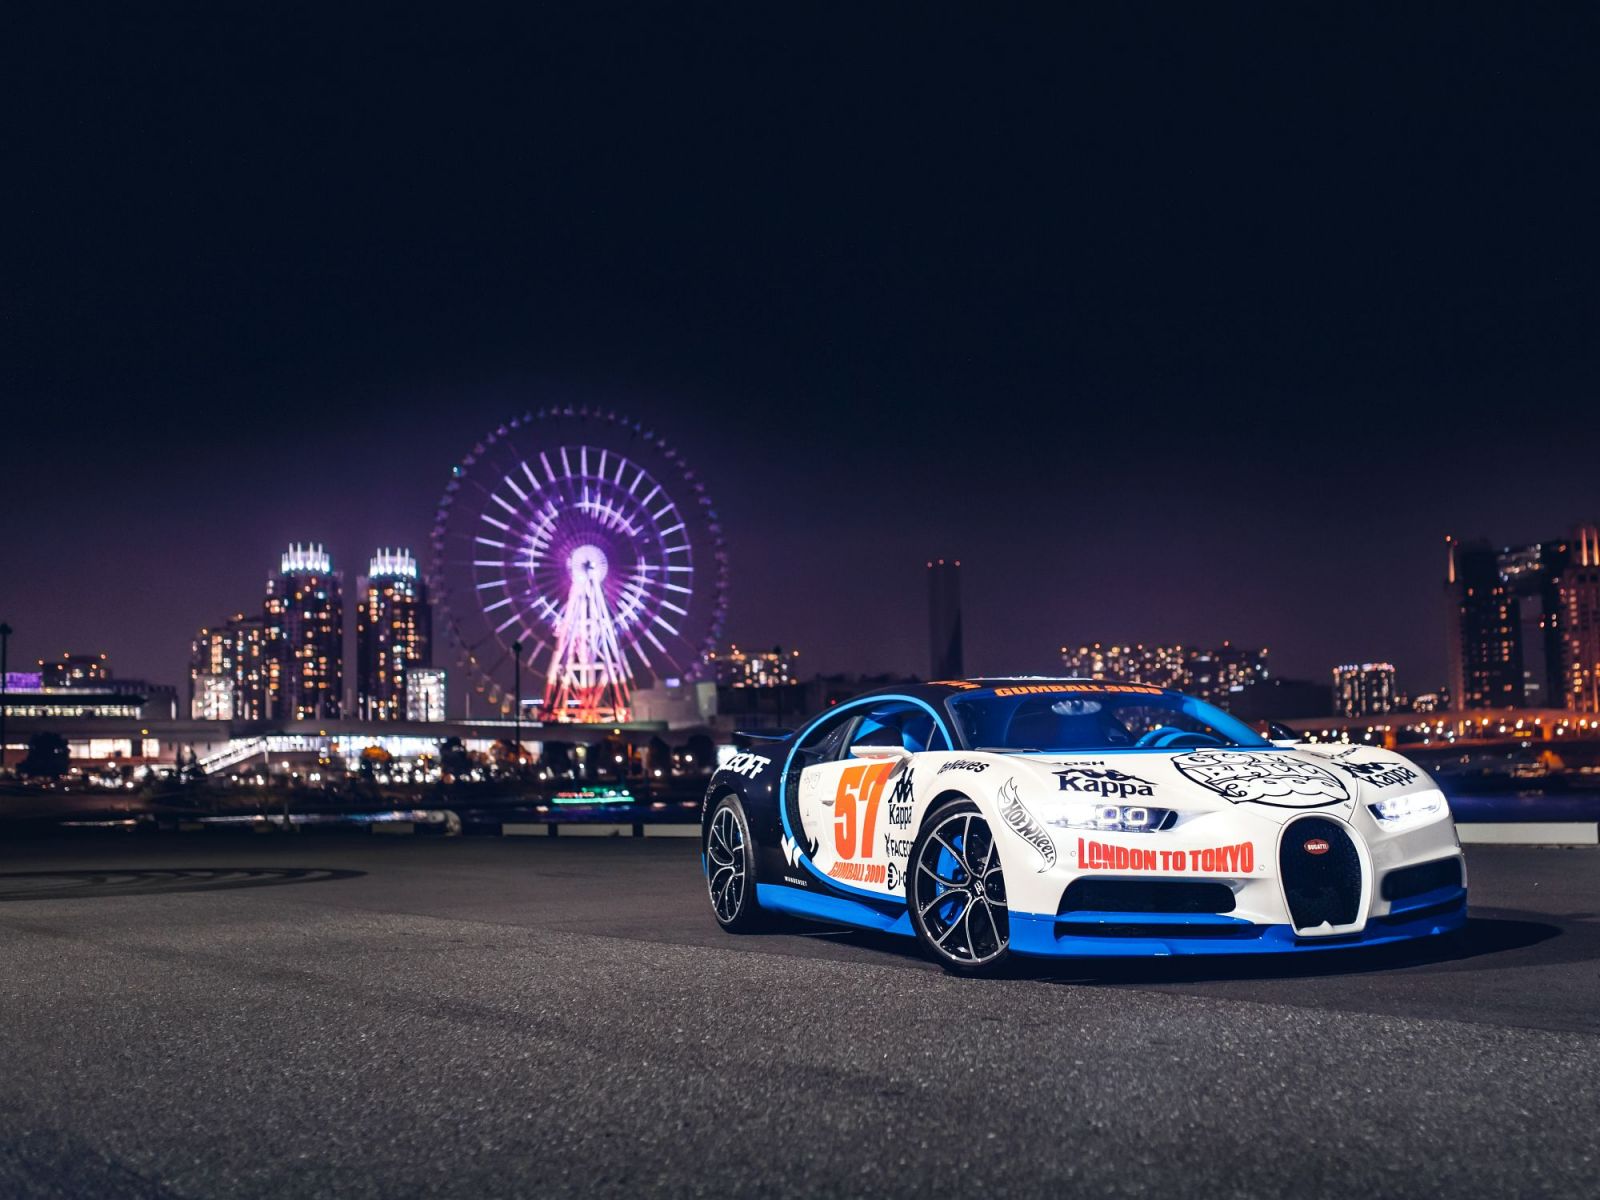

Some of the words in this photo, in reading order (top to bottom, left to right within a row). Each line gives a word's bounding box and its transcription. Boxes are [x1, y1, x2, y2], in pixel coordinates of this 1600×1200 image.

[995, 685, 1103, 697] GUMBALL
[1106, 685, 1164, 695] 3000
[1058, 774, 1155, 798] Kappa
[1362, 766, 1418, 788] Kappa
[834, 762, 896, 860] 57
[889, 803, 912, 830] Kappa
[1001, 797, 1026, 827] HOT
[1078, 837, 1156, 871] LONDON
[1159, 850, 1186, 871] TO
[1189, 841, 1254, 873] TOKYO
[827, 861, 864, 882] GUMBALL
[864, 864, 886, 884] 3000
